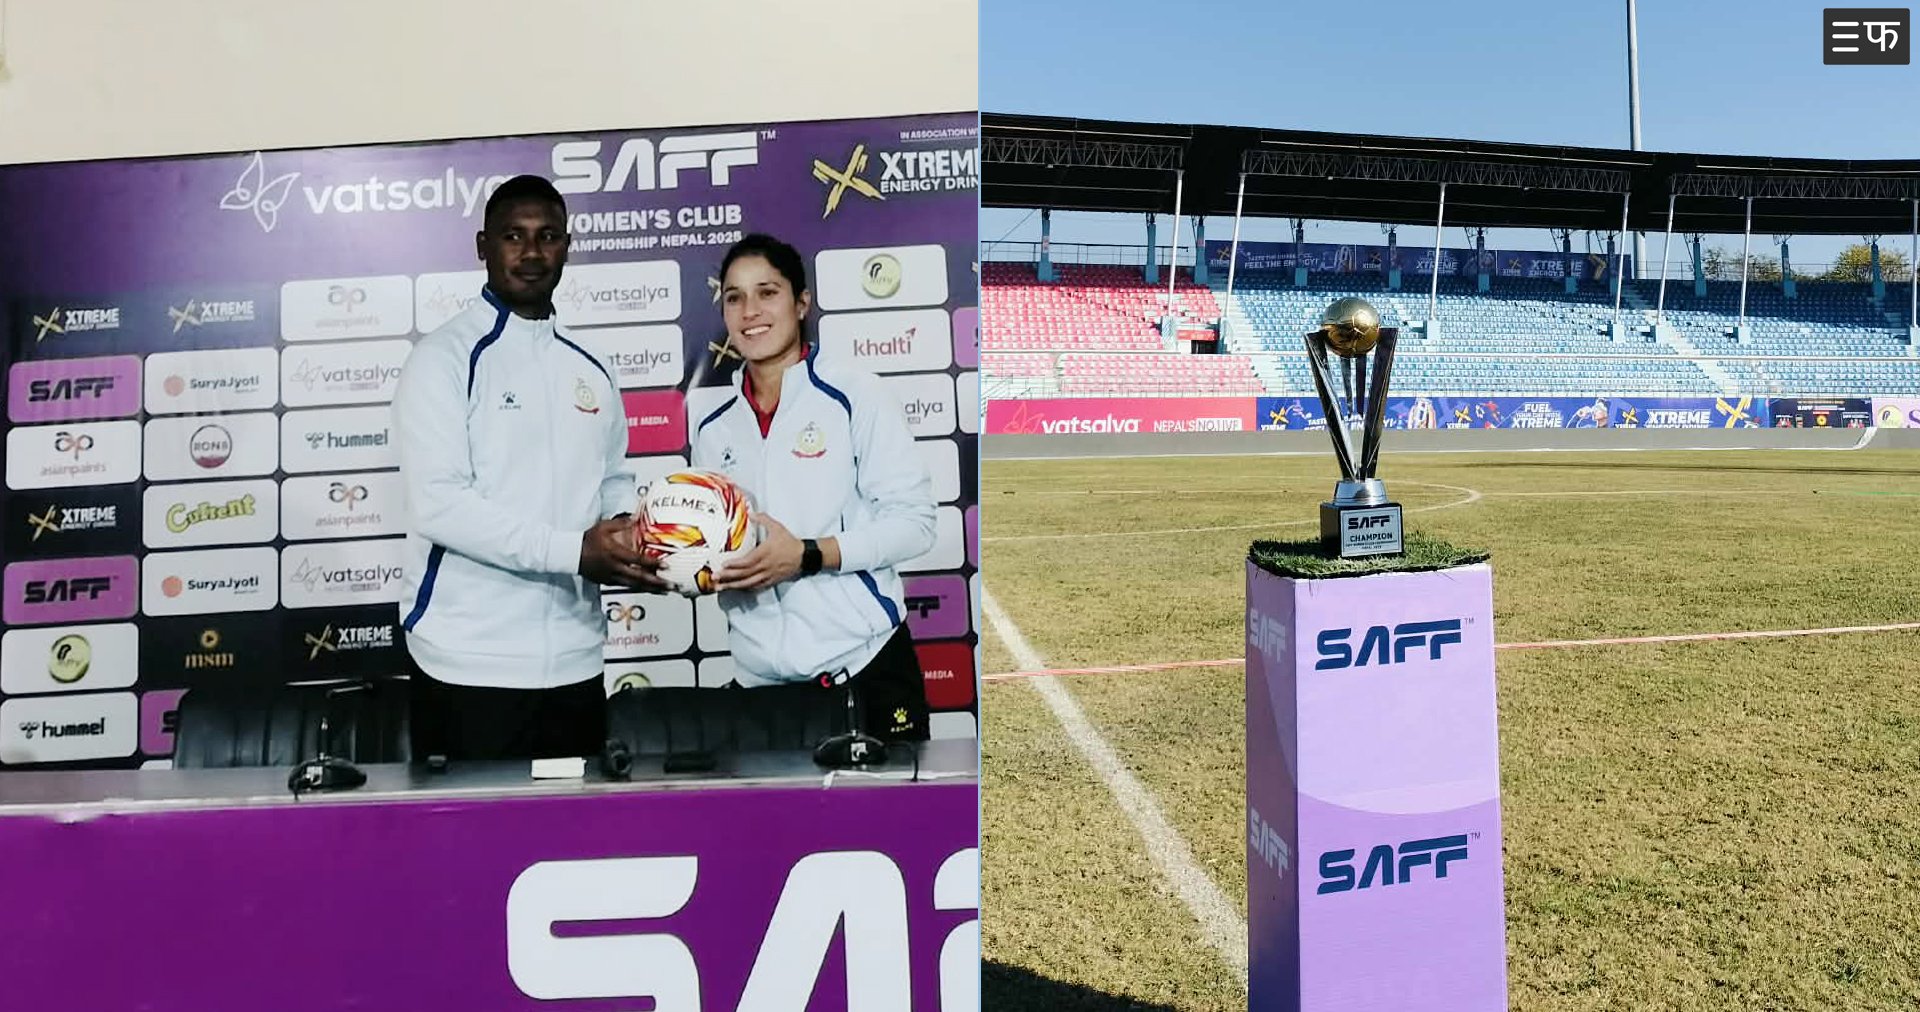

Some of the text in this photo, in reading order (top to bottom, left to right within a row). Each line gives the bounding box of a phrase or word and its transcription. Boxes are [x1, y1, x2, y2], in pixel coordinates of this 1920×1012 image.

[900, 131, 910, 140] IN
[911, 128, 967, 139] ASSOCIATION
[551, 131, 758, 195] SAFF
[881, 177, 978, 194] ENERGY DRIN
[677, 204, 742, 229] CLUB
[568, 235, 660, 253] AMPIONSHIP
[661, 233, 706, 249] NEPAL
[590, 284, 670, 303] vatsalya
[65, 307, 119, 325] XTREME
[201, 300, 255, 317] XTREME
[853, 333, 912, 357] khalti
[609, 349, 672, 368] tsalya
[28, 376, 115, 402] SAFF
[904, 397, 944, 419] alya
[1524, 402, 1551, 413] FUEL
[1647, 410, 1711, 424] XTREME
[1512, 417, 1563, 429] XTREME
[327, 428, 389, 448] hummel
[651, 496, 706, 512] KELME
[61, 505, 117, 524] XTREME
[1348, 515, 1391, 530] SAFF
[1349, 532, 1393, 543] CHAMPION
[187, 575, 260, 591] SuryaJyoti
[322, 563, 404, 585] vatsalya
[23, 577, 111, 604] SAFF
[337, 625, 393, 643] XTREME
[1315, 618, 1462, 671] SAFF
[924, 669, 954, 680] MEDIA
[41, 716, 106, 739] hummel
[1316, 833, 1468, 896] SAFF
[505, 847, 978, 1012] SA
